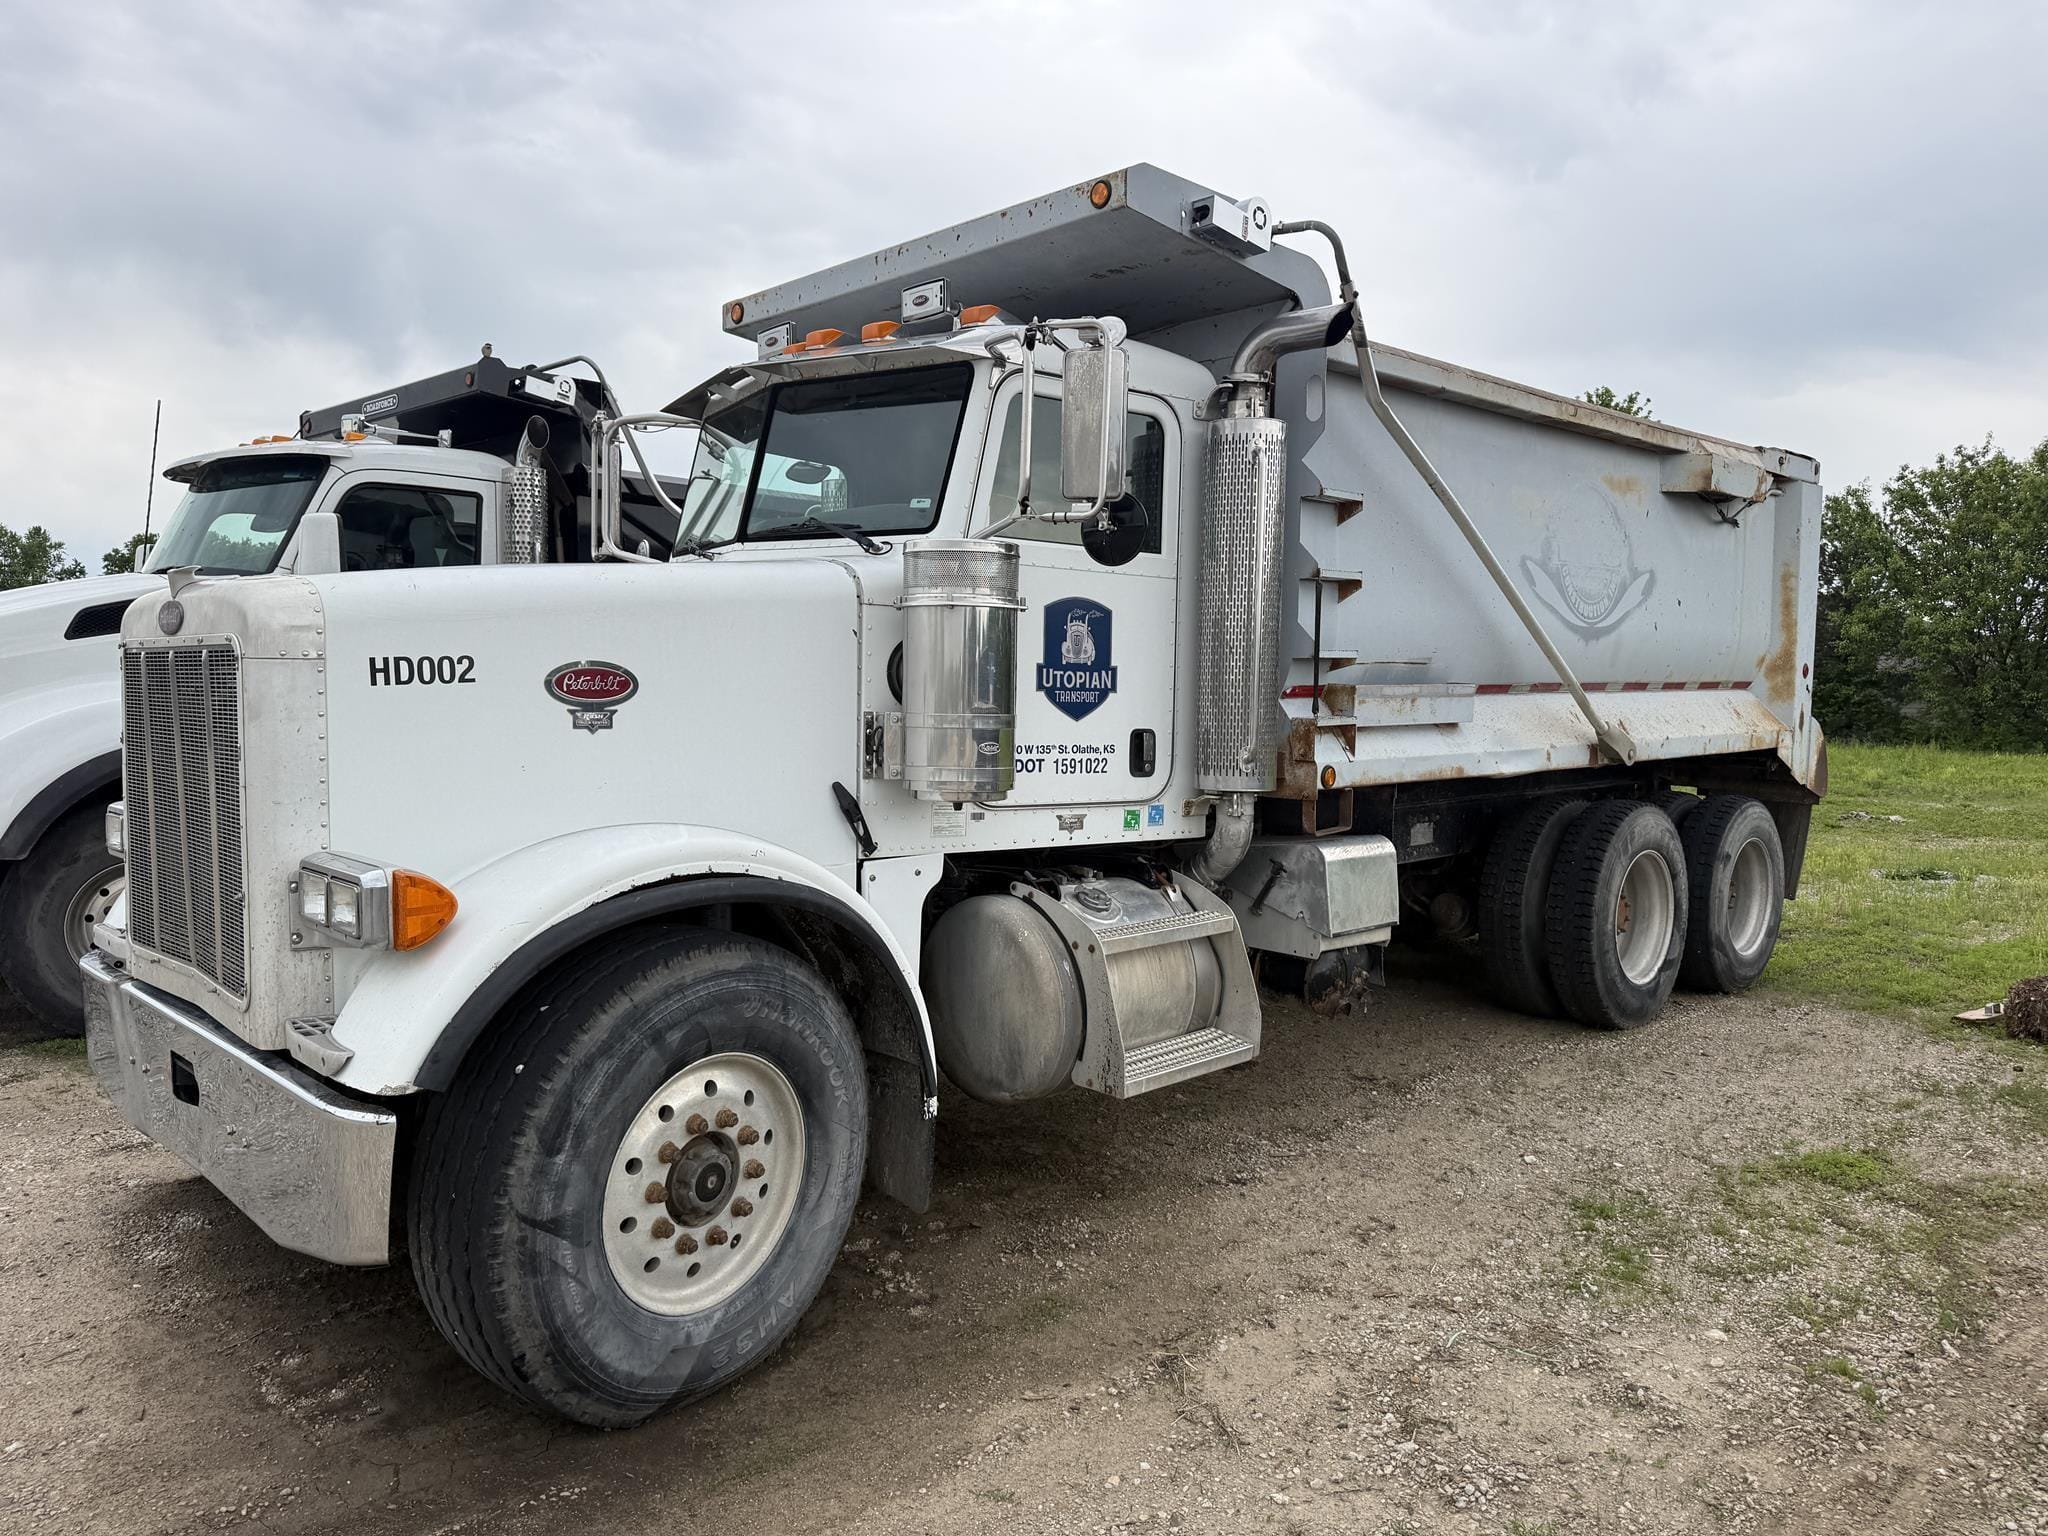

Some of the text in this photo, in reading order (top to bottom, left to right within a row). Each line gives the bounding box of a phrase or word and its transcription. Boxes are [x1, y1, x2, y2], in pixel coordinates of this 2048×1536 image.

[368, 655, 476, 687] HD002
[1042, 668, 1112, 689] UTOPIAN
[563, 673, 625, 691] Peterbilt
[1055, 690, 1100, 703] TRANSPORT
[1024, 744, 1034, 755] W
[1058, 744, 1070, 754] St.
[1071, 743, 1102, 756] Olathe,
[1103, 744, 1116, 754] KS
[1015, 757, 1108, 775] DOT 1591022
